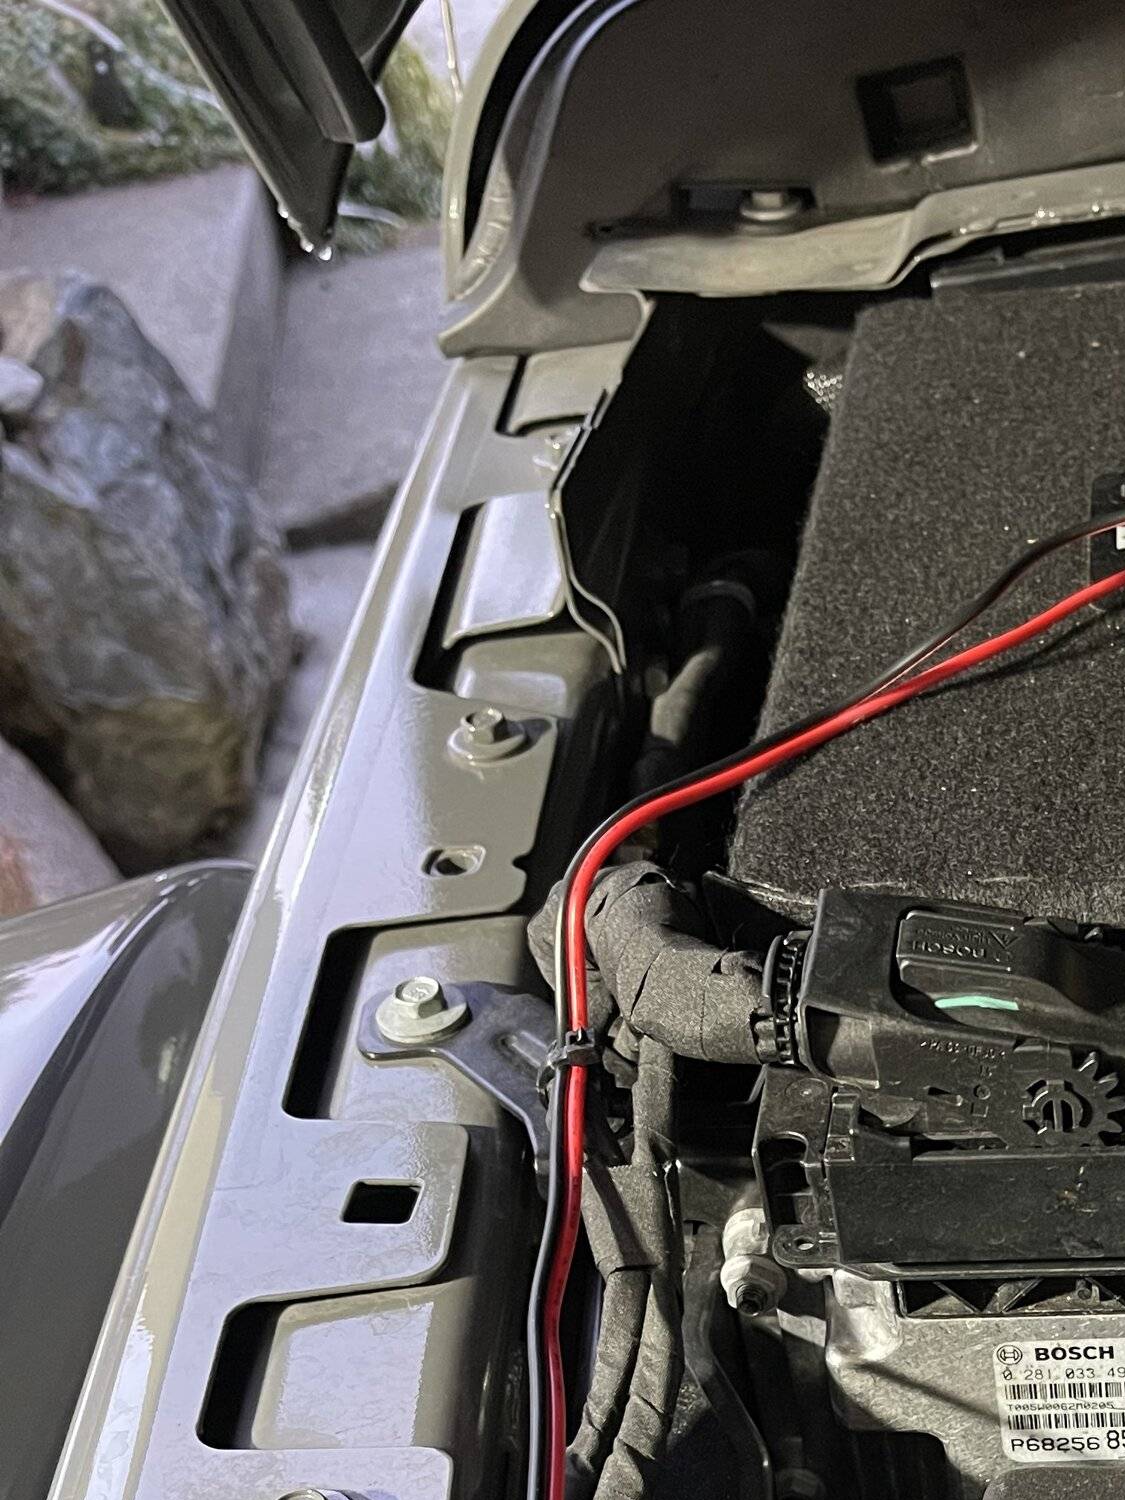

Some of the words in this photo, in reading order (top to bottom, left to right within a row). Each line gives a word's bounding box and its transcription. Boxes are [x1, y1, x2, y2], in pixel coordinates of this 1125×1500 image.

[1034, 1345, 1115, 1362] BOSCH
[1002, 1368, 1014, 1381] 0
[1023, 1368, 1051, 1380] 281
[1065, 1367, 1096, 1380] 033
[1010, 1436, 1100, 1452] P68256
